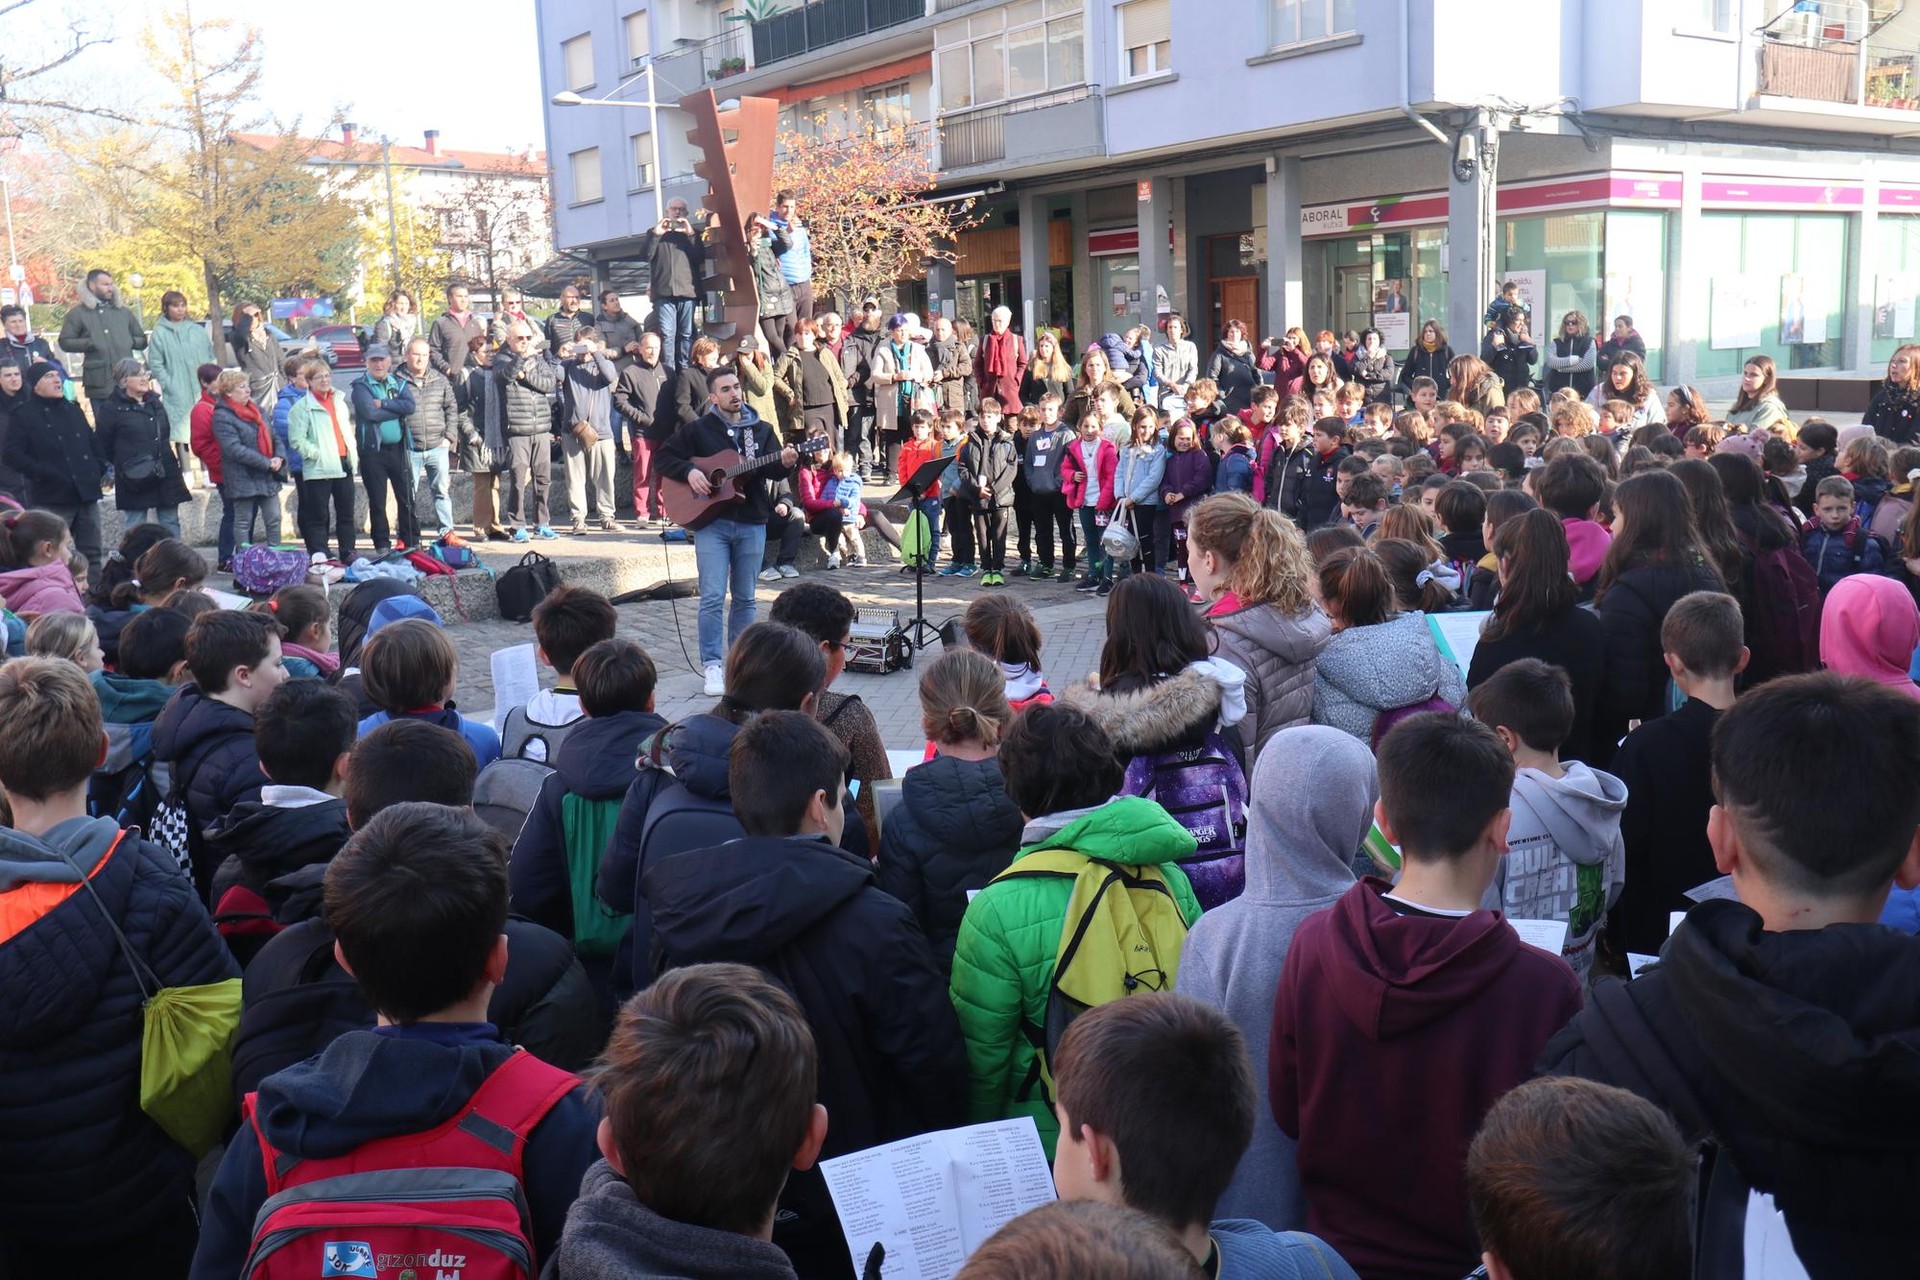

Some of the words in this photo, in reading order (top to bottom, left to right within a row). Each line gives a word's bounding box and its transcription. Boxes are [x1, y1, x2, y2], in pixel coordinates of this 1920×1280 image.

[1302, 208, 1343, 223] ABORAL
[1189, 826, 1216, 837] ANGER
[328, 1254, 352, 1272] JON
